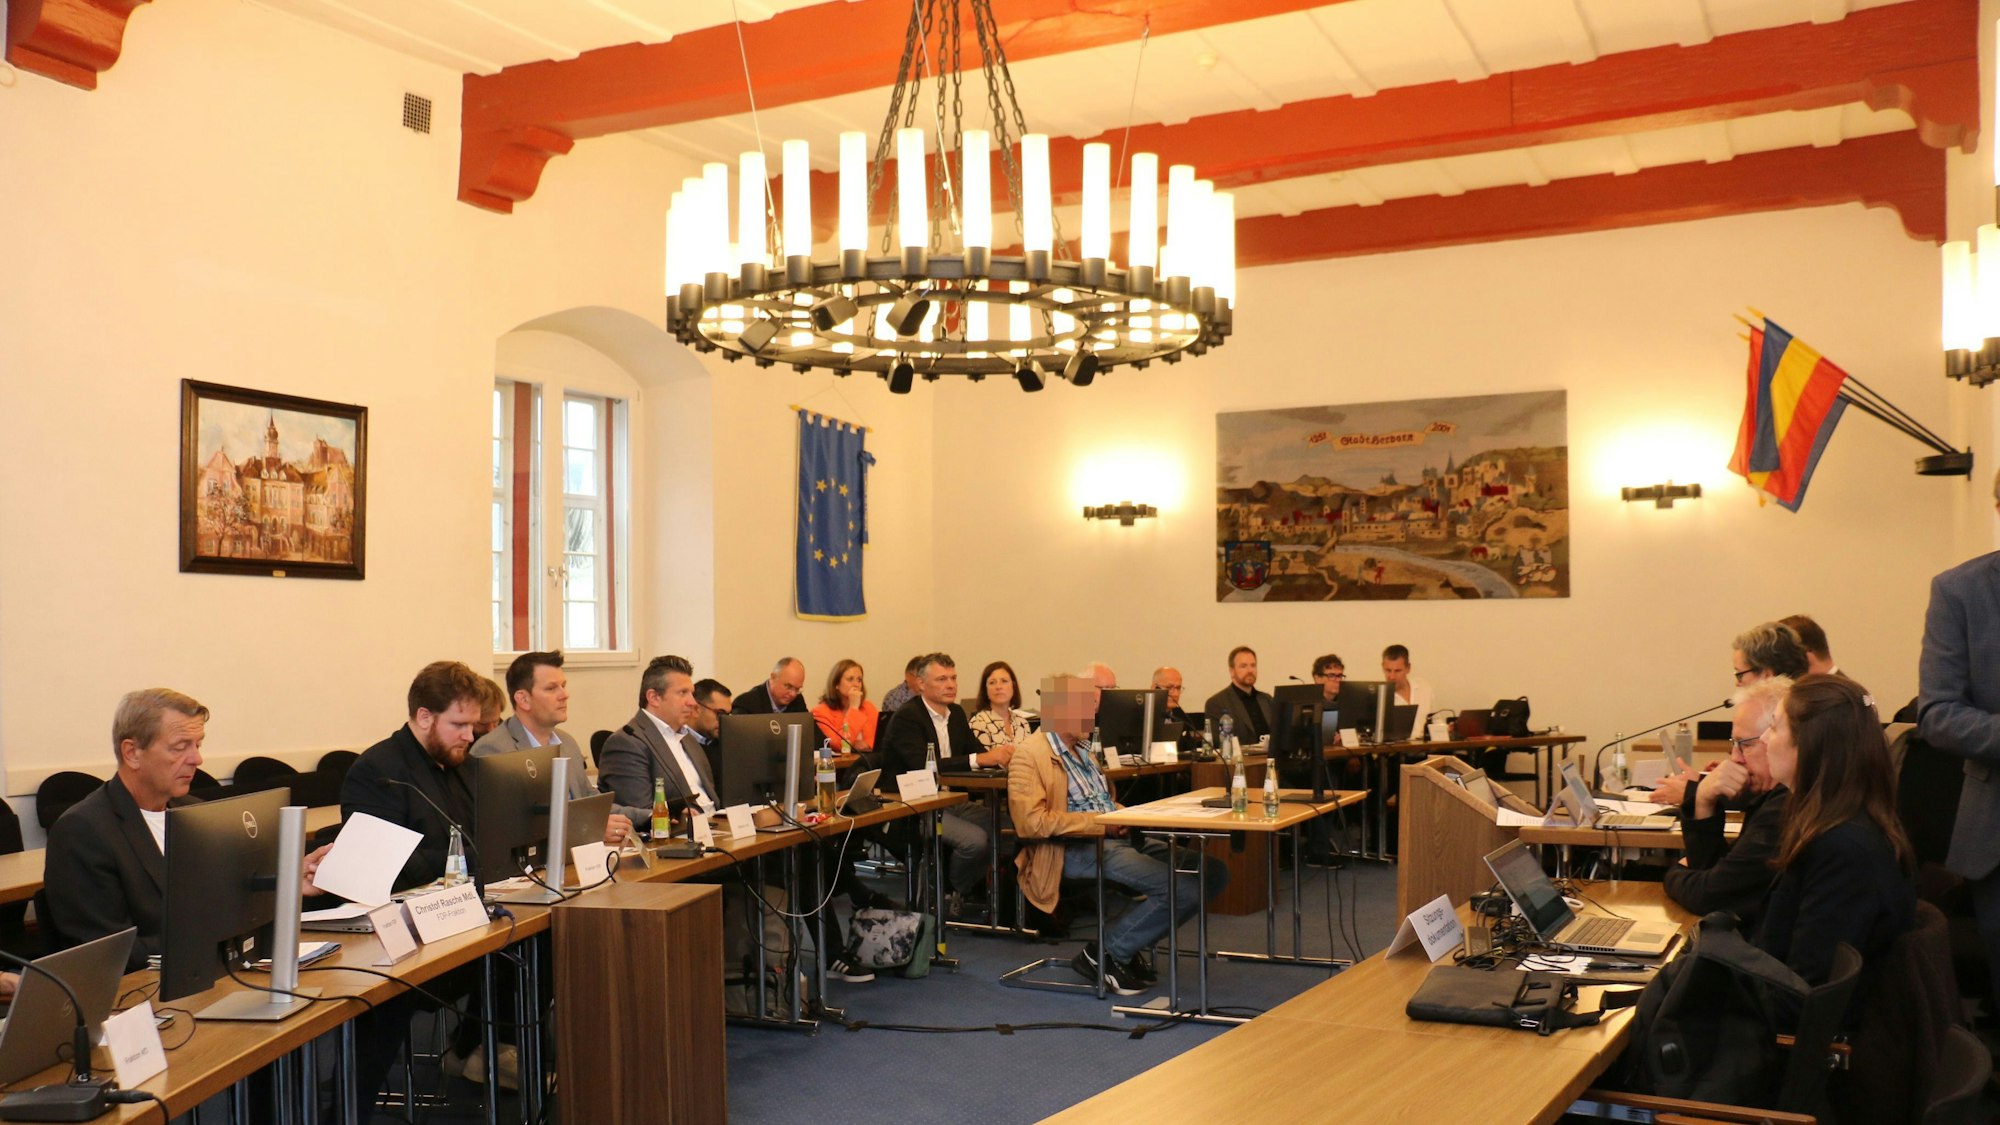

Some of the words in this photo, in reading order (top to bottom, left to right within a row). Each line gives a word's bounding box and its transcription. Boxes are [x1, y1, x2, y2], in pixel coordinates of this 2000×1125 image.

[415, 901, 440, 914] Christof
[440, 897, 463, 908] Rasche
[463, 891, 476, 902] MdL
[436, 907, 466, 920] FDP-Fraktion
[1423, 908, 1444, 925] Sitzungs-
[1427, 919, 1457, 946] dokumentation
